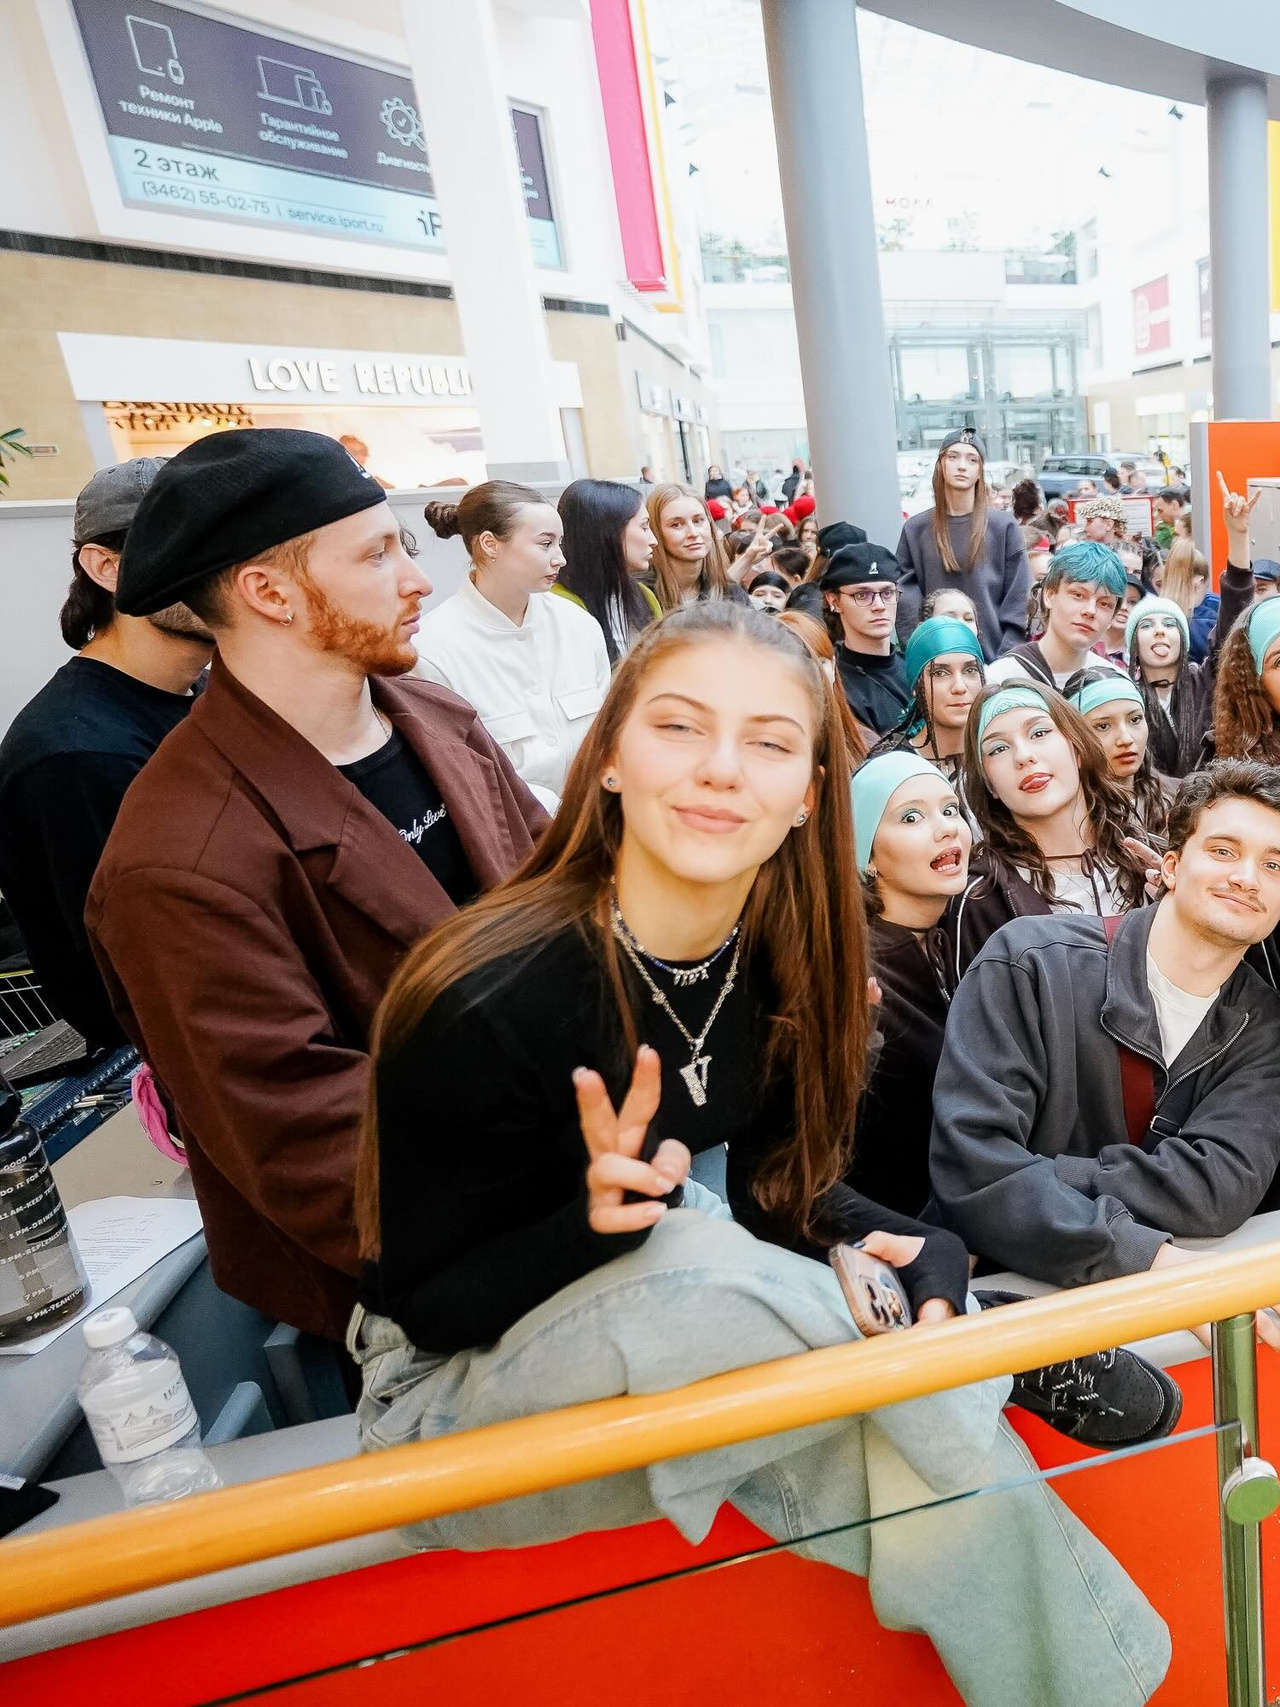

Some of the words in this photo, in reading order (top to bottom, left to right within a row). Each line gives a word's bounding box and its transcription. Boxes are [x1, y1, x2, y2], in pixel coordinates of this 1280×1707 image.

[139, 84, 195, 110] Ремонт
[118, 100, 182, 124] техники
[183, 112, 224, 134] Apple
[134, 149, 151, 168] 2
[157, 157, 220, 181] этаж
[376, 151, 430, 174] Диагност
[142, 180, 197, 205] (3462)
[199, 190, 271, 214] 55-02-75
[248, 358, 341, 392] LOVE
[354, 362, 473, 395] REPUBLI
